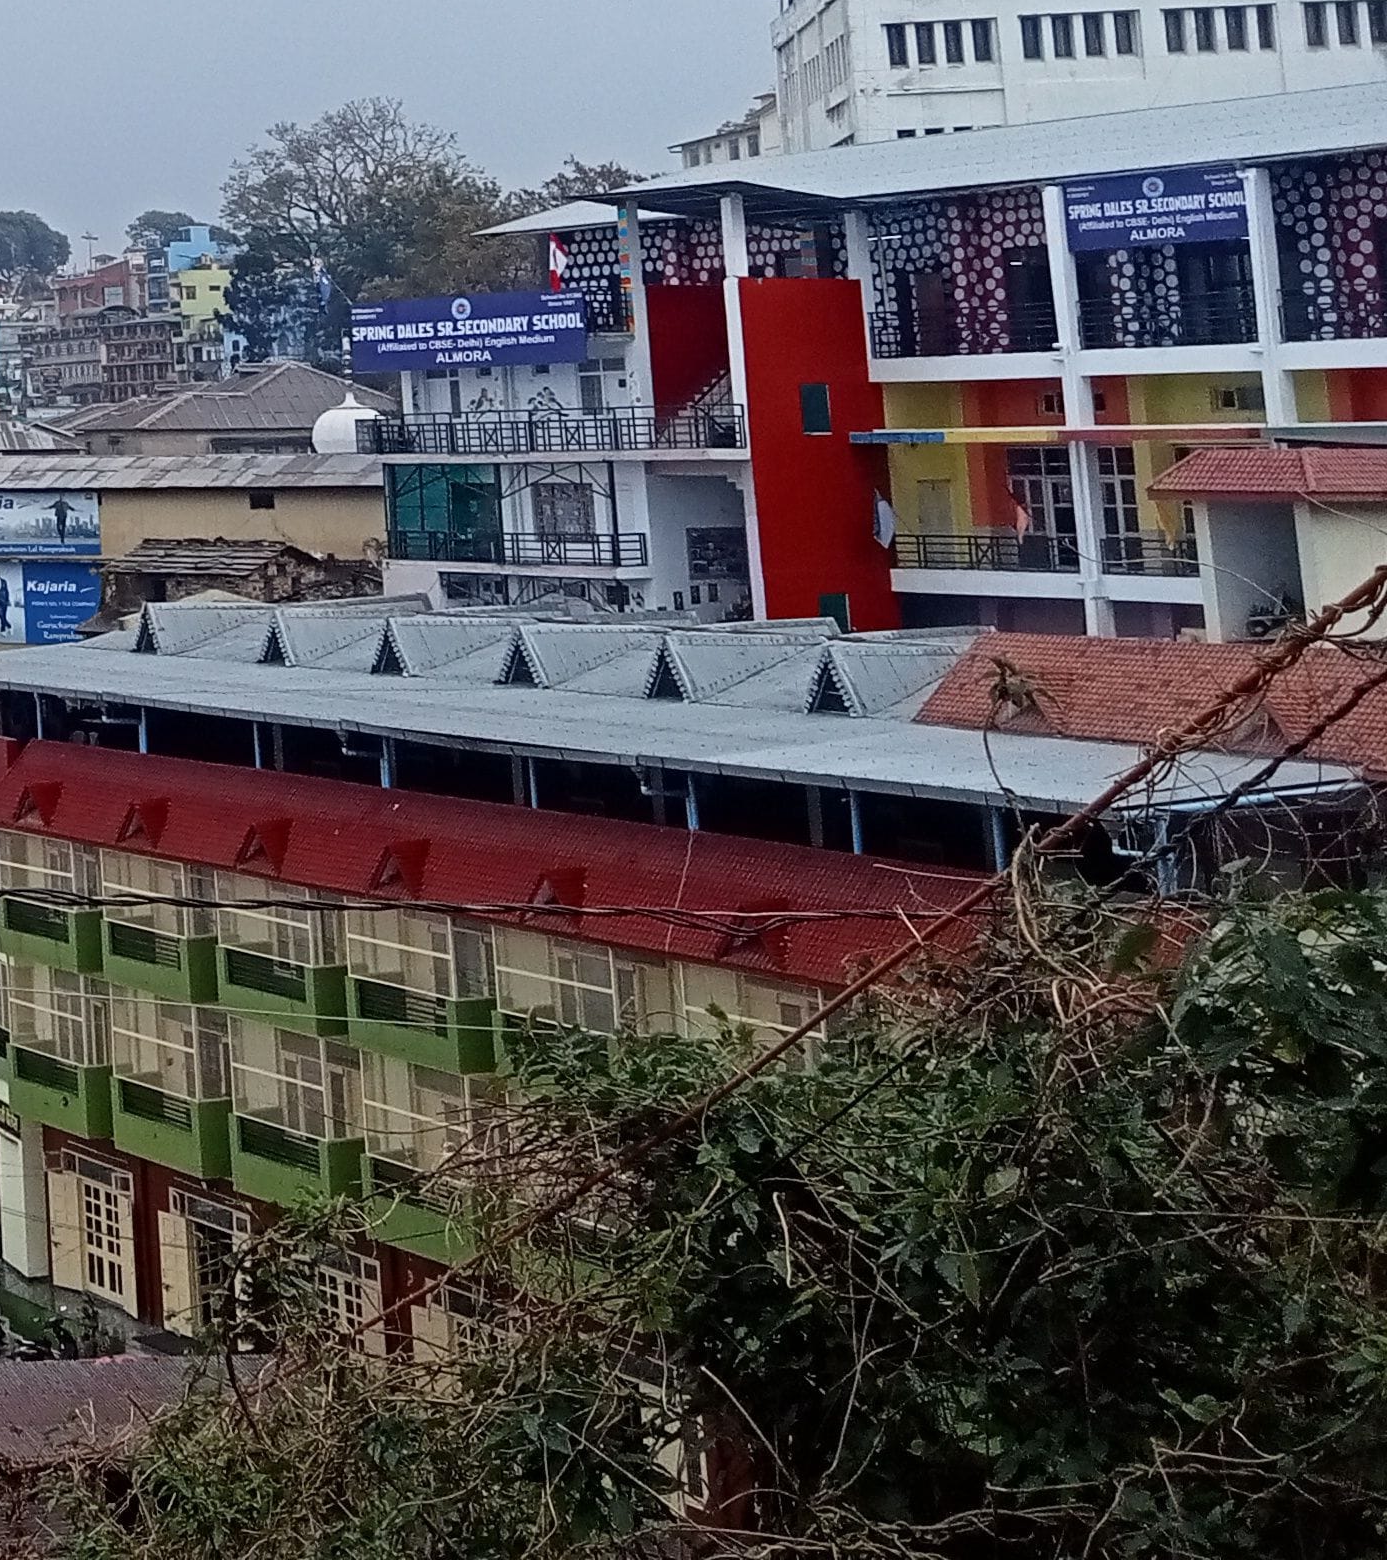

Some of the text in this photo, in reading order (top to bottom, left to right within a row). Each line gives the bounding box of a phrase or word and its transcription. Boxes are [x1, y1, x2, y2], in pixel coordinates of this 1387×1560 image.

[1068, 203, 1102, 220] SPRING
[1104, 200, 1134, 216] DALES
[1208, 190, 1247, 208] SCHOOL
[1130, 227, 1186, 241] ALMORA
[352, 312, 584, 342] SPRING DALES SR.SECONDARY SCHOOL
[418, 341, 427, 350] to
[484, 336, 517, 349] English
[518, 334, 555, 345] Medium
[435, 350, 492, 364] ALMORA
[27, 580, 76, 594] Kajaria
